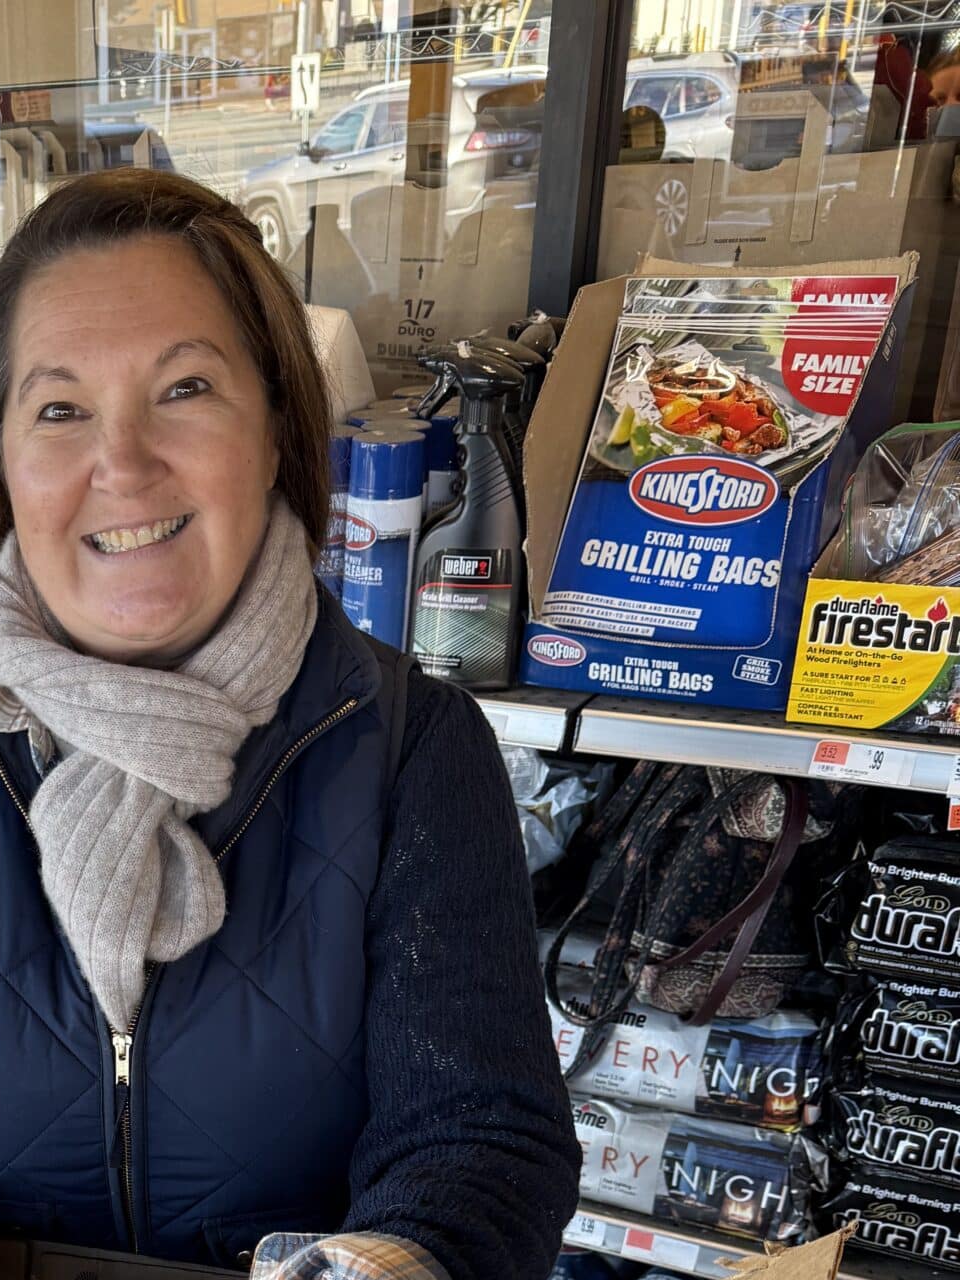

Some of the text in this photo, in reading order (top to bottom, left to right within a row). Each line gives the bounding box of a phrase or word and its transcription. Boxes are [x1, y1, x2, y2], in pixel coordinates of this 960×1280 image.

[404, 298, 436, 320] 1/7
[398, 325, 436, 337] DURO
[800, 375, 854, 395] SIZE
[639, 468, 767, 514] KINGSFORD
[644, 530, 732, 553] EXTRA TOUGH
[444, 556, 478, 576] weber
[580, 539, 782, 588] GRILLING BAGS
[830, 595, 899, 617] duraflame
[532, 638, 581, 660] KINGSFORD
[807, 646, 818, 655] At
[818, 646, 843, 657] Home
[855, 649, 903, 662] On-the-Go
[624, 656, 679, 670] EXTRA TOUGH
[746, 657, 770, 668] GRILL
[805, 654, 881, 669] Wood Firelighters
[588, 661, 663, 688] GRILLING
[668, 671, 714, 692] BAGS
[740, 671, 770, 682] STEAM
[831, 673, 854, 681] START
[800, 686, 854, 698] FAST LIGHTING
[797, 702, 833, 712] COMPACT
[797, 709, 864, 721] WATER RESISTANT
[887, 864, 936, 882] Brighter
[851, 893, 960, 956] duraf
[889, 982, 937, 998] Brighter
[861, 1007, 960, 1066] duraf
[874, 1086, 919, 1104] Brighter
[846, 1108, 960, 1175] durafl
[671, 1160, 788, 1213] NIGH
[862, 1184, 951, 1213] Brighter Burning
